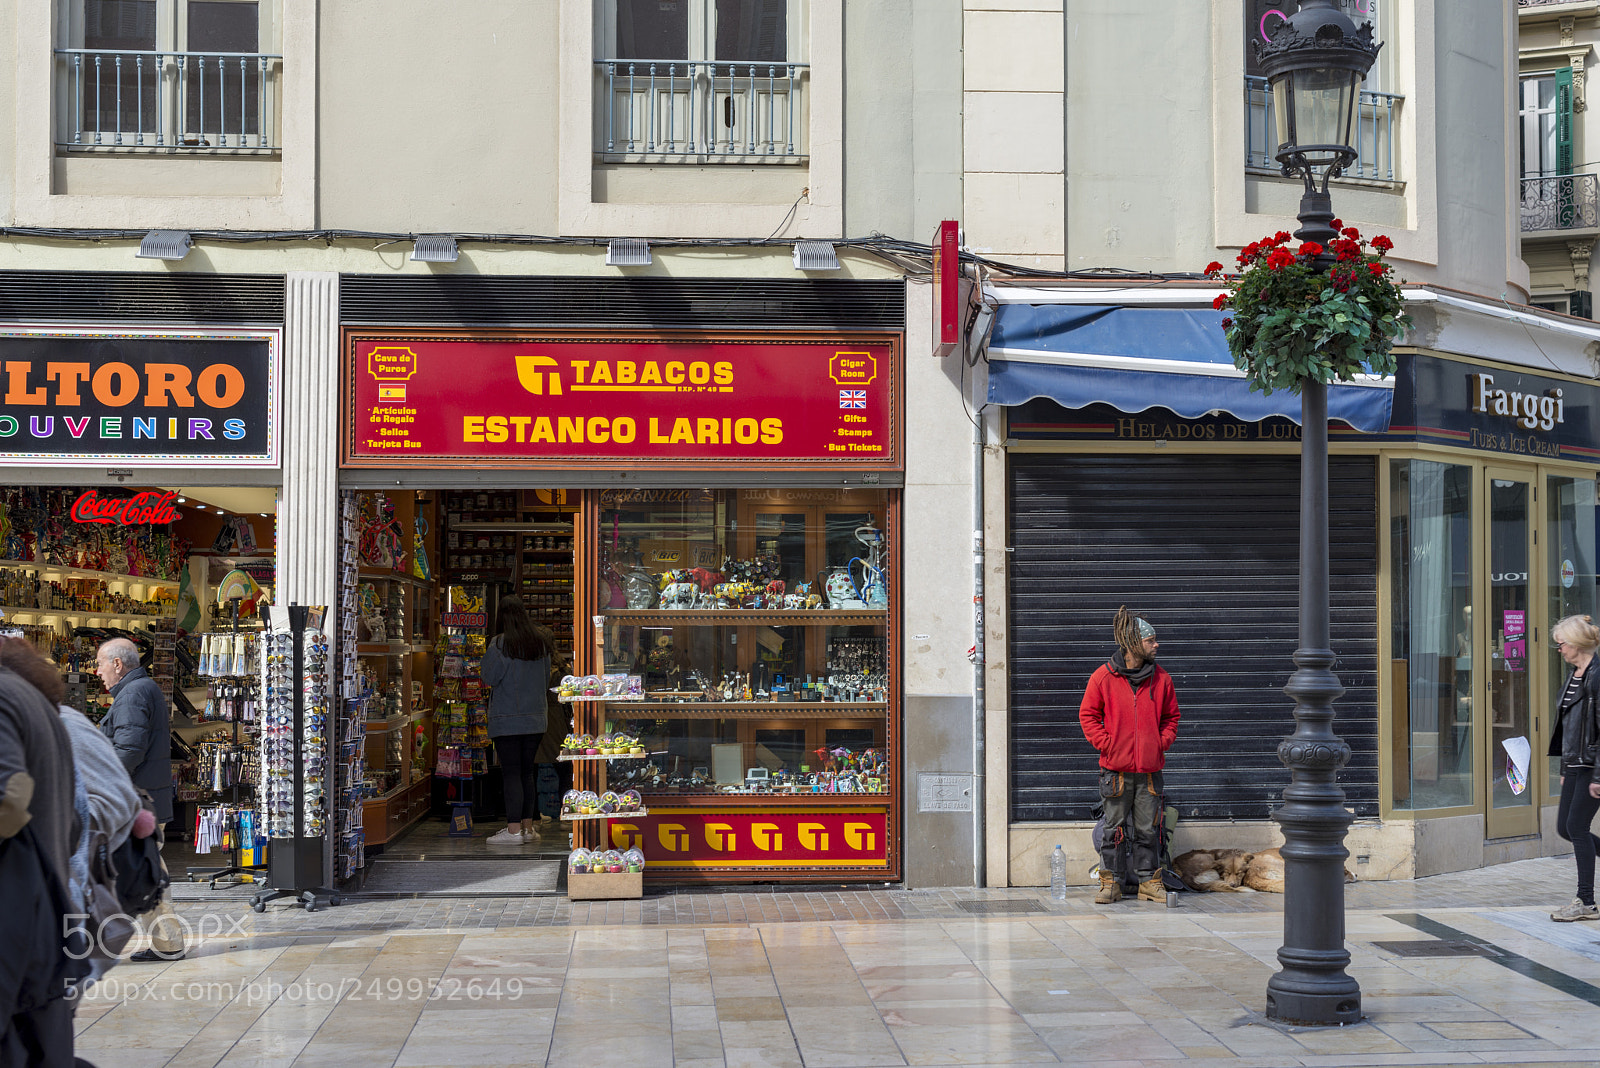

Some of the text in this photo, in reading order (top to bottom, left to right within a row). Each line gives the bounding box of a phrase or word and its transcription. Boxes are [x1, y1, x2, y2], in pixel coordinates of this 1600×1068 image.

[374, 354, 411, 363] Cava de
[840, 358, 866, 369] Cigar
[378, 365, 407, 373] Puros
[570, 360, 734, 385] TABACOS
[840, 369, 865, 378] Room
[0, 361, 245, 409] LTORO
[1479, 373, 1565, 431] Farggi
[372, 405, 417, 415] Artículos
[370, 414, 415, 424] de Regalo
[843, 414, 867, 423] Gifts
[0, 415, 247, 440] OUVENIRS
[380, 427, 409, 436] Sellos
[463, 415, 784, 445] ESTANCO LARIOS
[837, 428, 873, 437] Stamps
[1117, 418, 1217, 439] HELADOS
[1223, 424, 1248, 439] DE
[367, 440, 422, 449] Tarjeta Bus
[828, 443, 882, 452] Bus Tickets
[1509, 433, 1526, 453] ICE
[1527, 435, 1560, 457] CREAM
[70, 489, 181, 526] Coca-Cola
[443, 613, 487, 627] HARIBO
